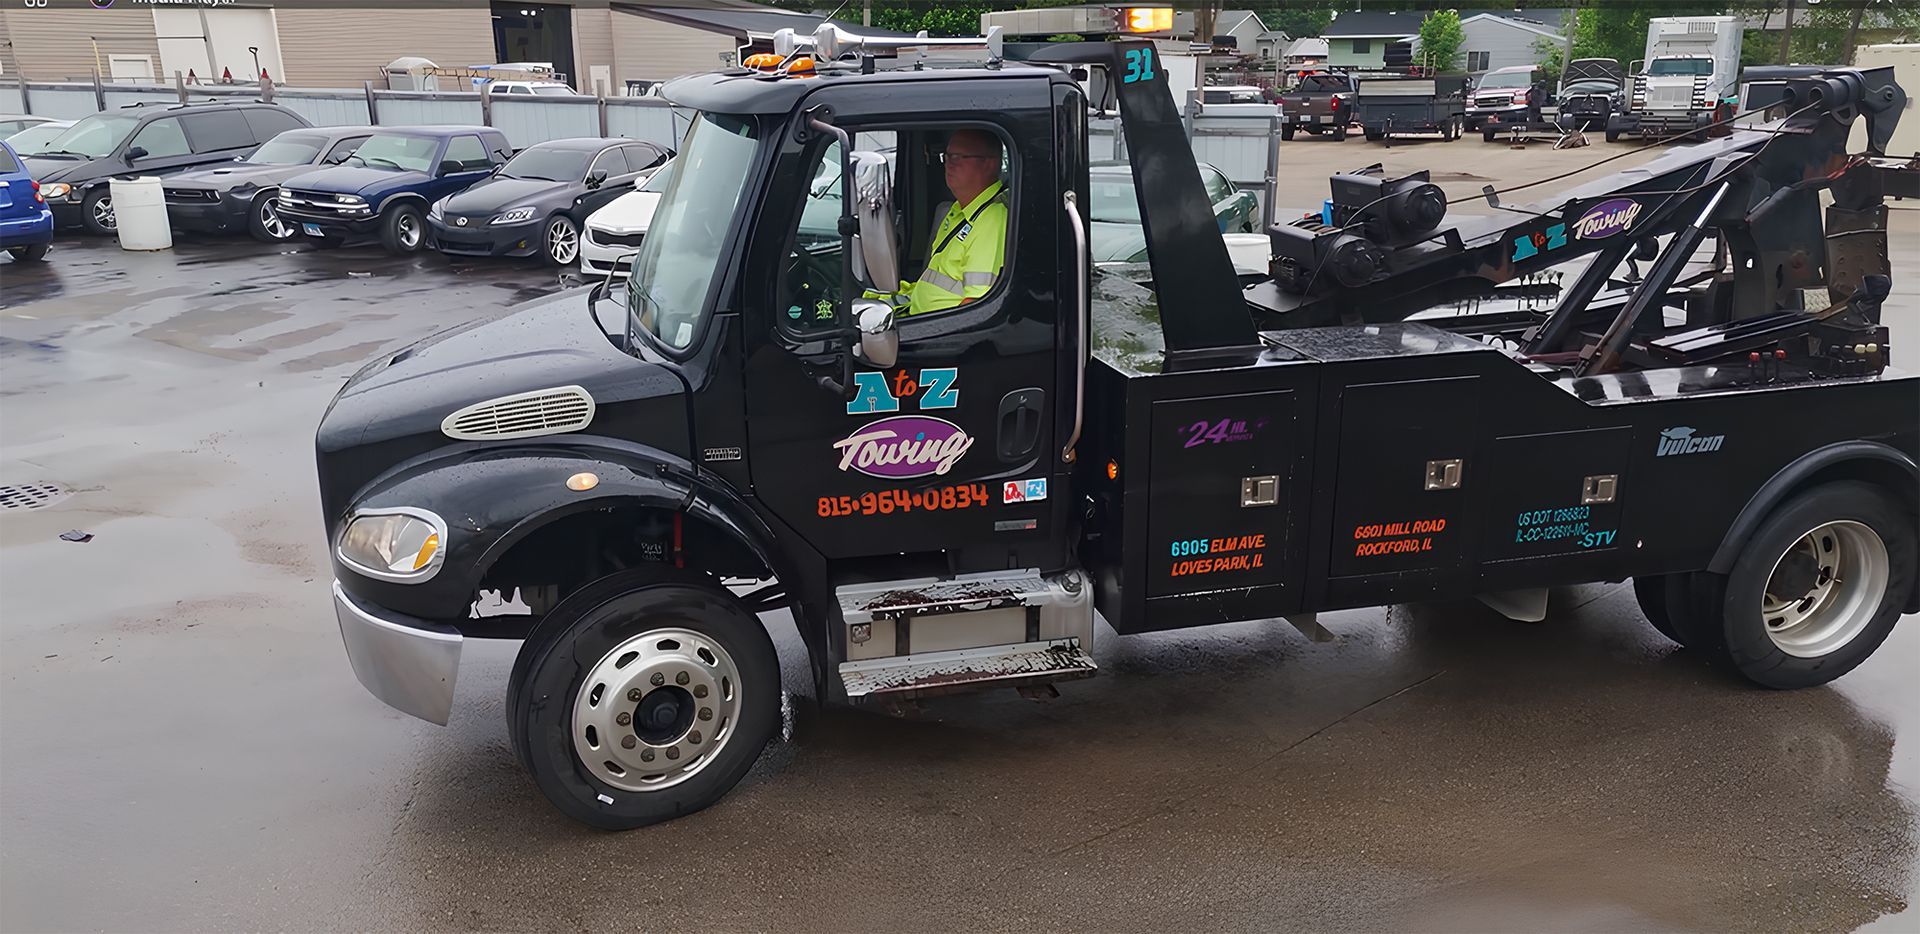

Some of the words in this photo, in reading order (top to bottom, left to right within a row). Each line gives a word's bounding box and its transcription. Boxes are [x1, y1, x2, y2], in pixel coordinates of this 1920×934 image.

[1124, 47, 1154, 83] 31
[1512, 235, 1538, 263] A
[1546, 223, 1568, 250] Z
[1572, 203, 1642, 240] Towing
[847, 371, 900, 414] A
[894, 369, 917, 397] to
[919, 367, 960, 409] Z
[1184, 418, 1231, 448] 24
[1656, 434, 1725, 456] Vulcan
[833, 430, 975, 475] Towing
[1384, 521, 1411, 536] MILL
[1412, 519, 1446, 534] ROAD
[1532, 509, 1552, 524] DOT
[1171, 539, 1209, 557] 6905
[1210, 537, 1238, 553] ELM
[1355, 540, 1420, 557] ROCKFORD,
[1421, 538, 1432, 550] IL
[1171, 559, 1213, 577] LOVES
[1213, 555, 1251, 572] PARK,
[1252, 553, 1264, 568] IL
